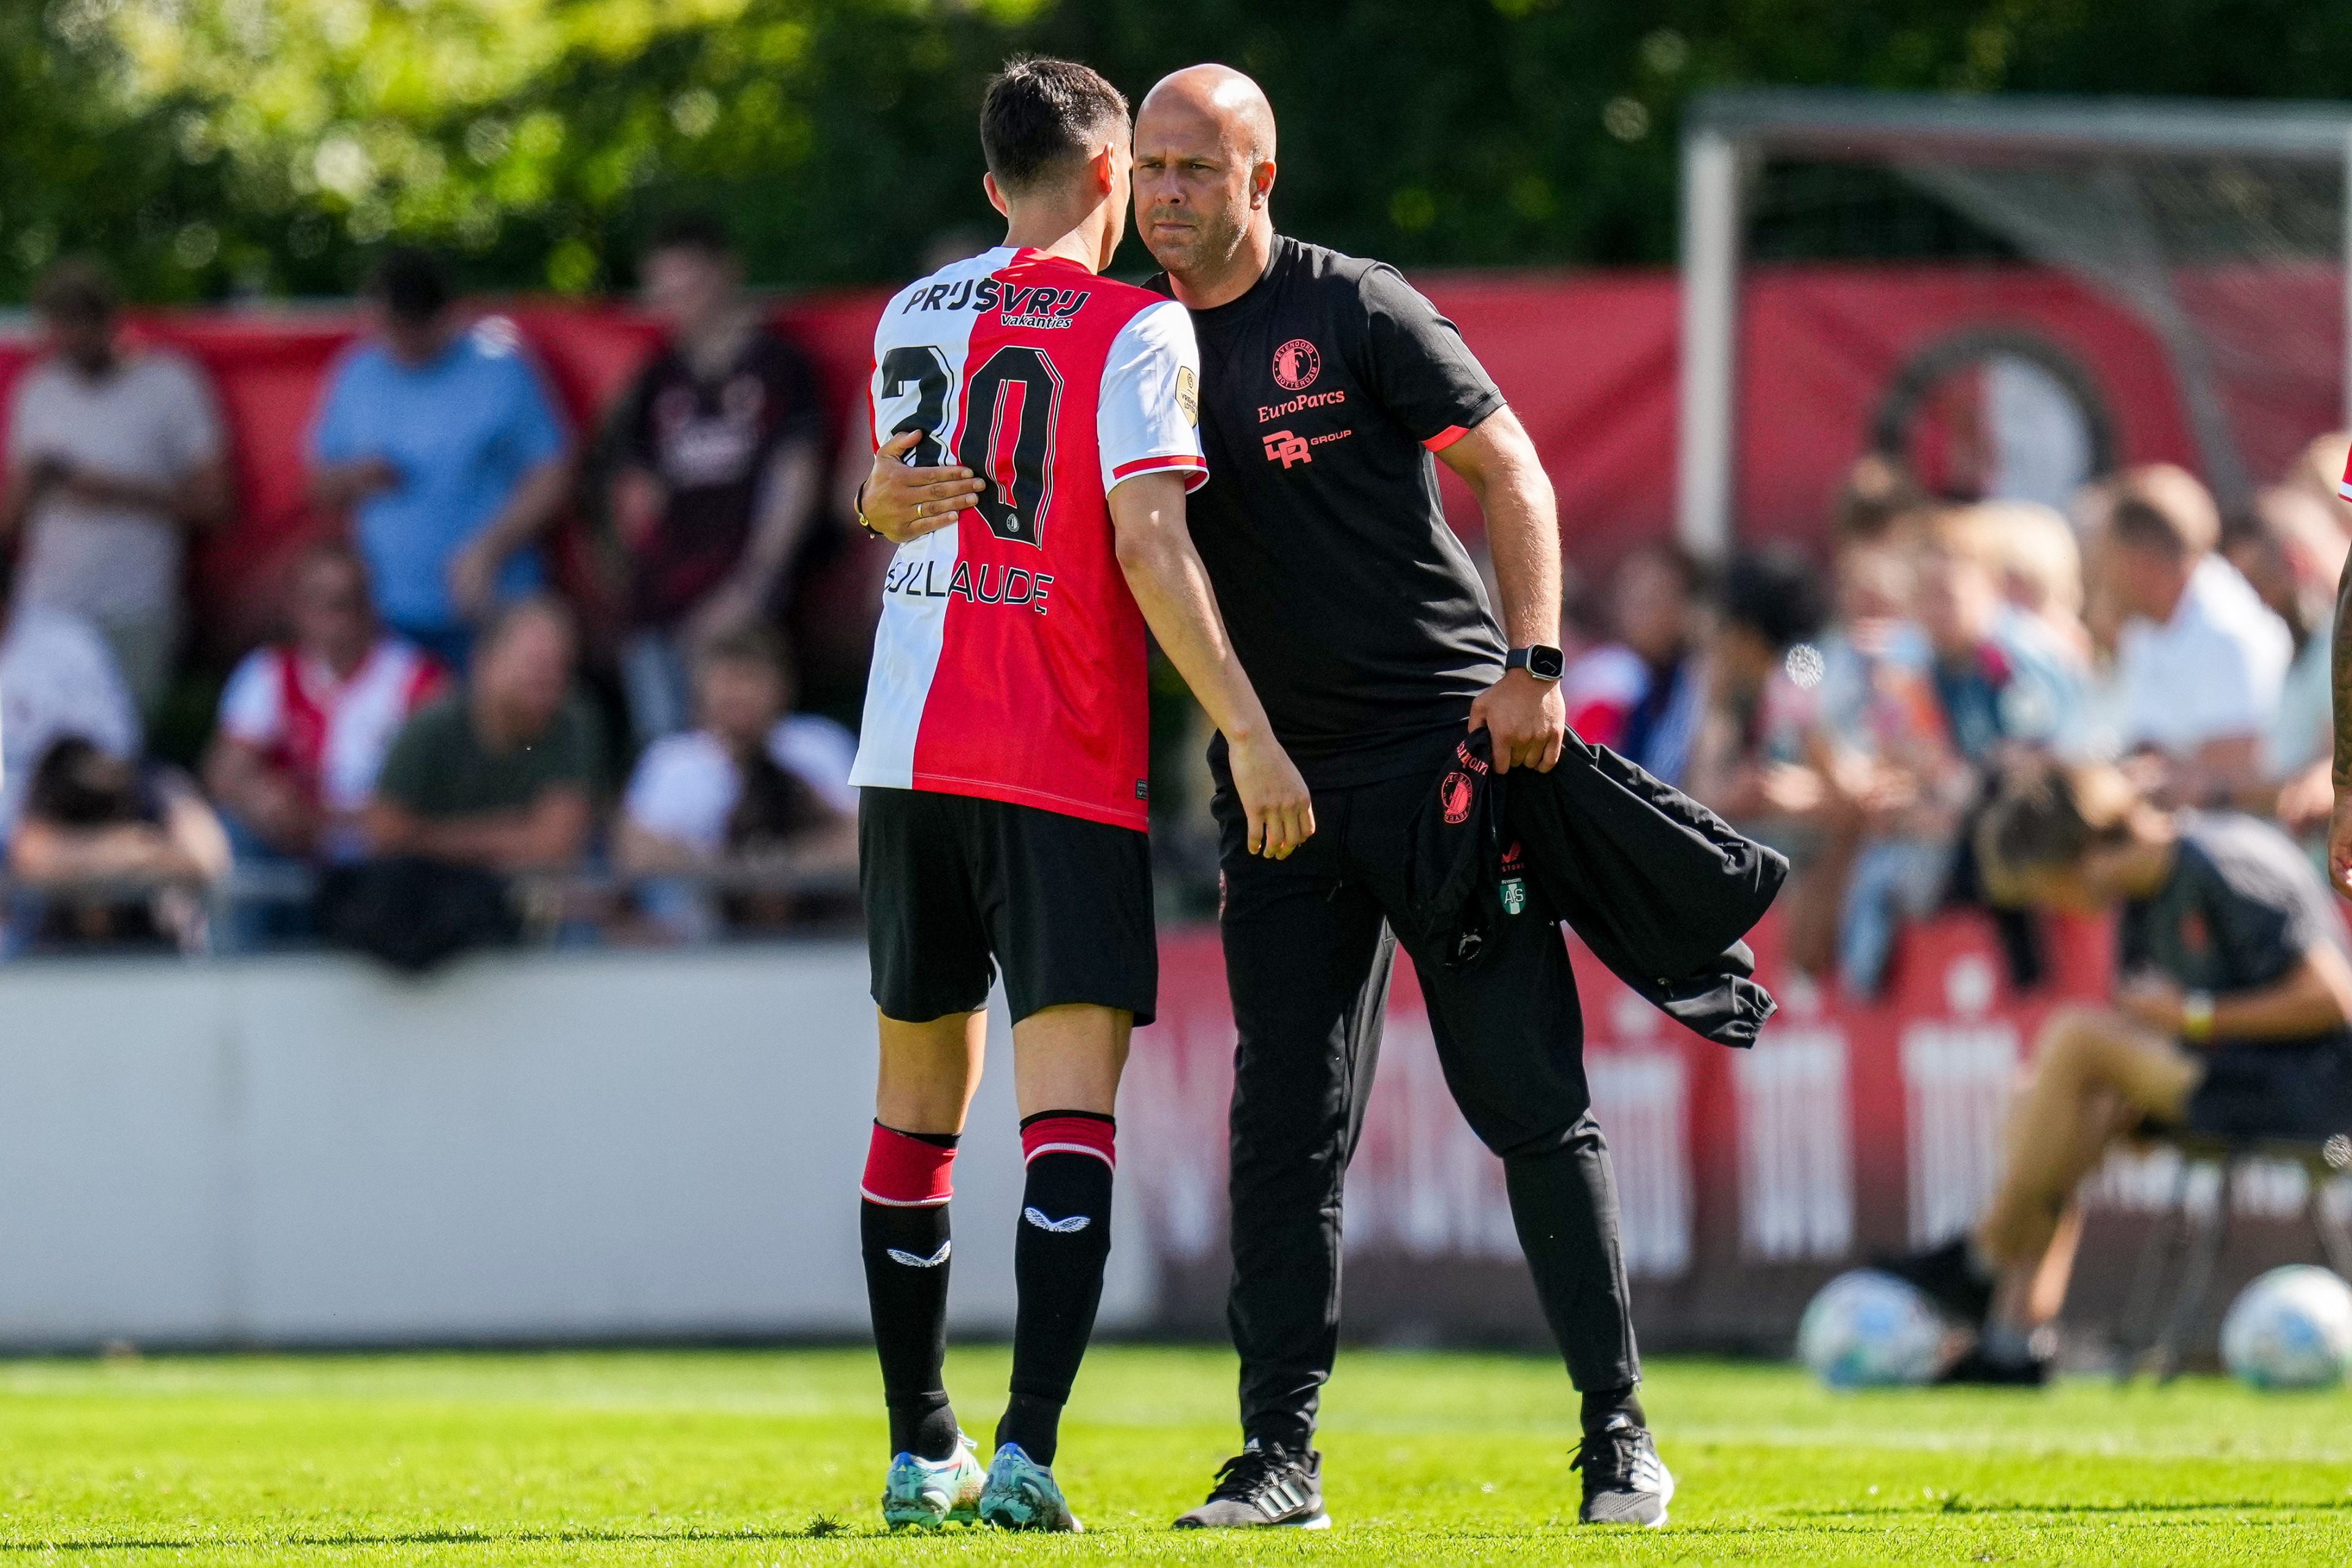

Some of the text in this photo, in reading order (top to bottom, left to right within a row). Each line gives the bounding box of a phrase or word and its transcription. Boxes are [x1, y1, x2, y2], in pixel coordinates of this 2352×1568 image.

[1000, 314, 1073, 330] vakanties
[1275, 341, 1314, 362] FEYENOORD
[1276, 366, 1317, 388] ROTTERDAM
[1258, 391, 1345, 423] EuroParcs
[881, 344, 1065, 551] 20
[1311, 430, 1352, 445] GROUP
[1504, 888, 1525, 904] AS
